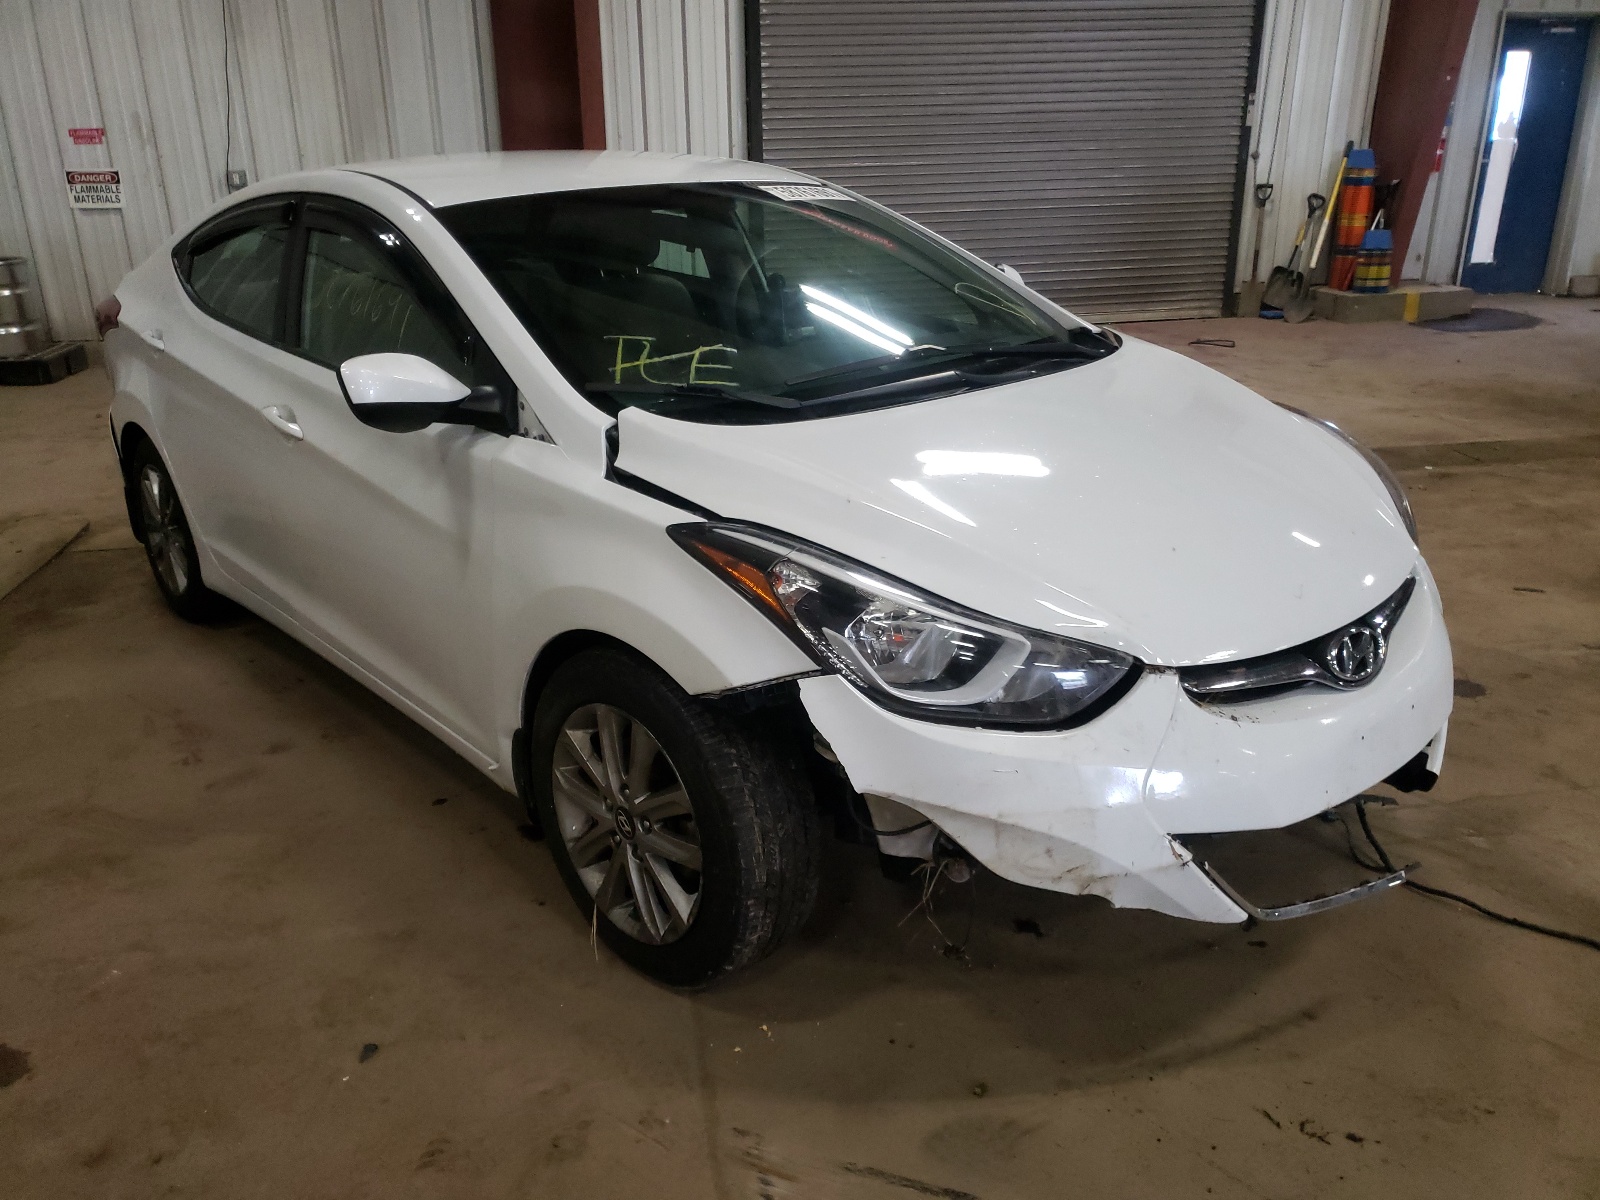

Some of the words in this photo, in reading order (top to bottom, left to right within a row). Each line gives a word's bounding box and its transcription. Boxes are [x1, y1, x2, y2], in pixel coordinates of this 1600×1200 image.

[74, 174, 112, 182] DANGER
[69, 185, 121, 194] FLAMMABLE
[74, 195, 120, 204] MATERIALS
